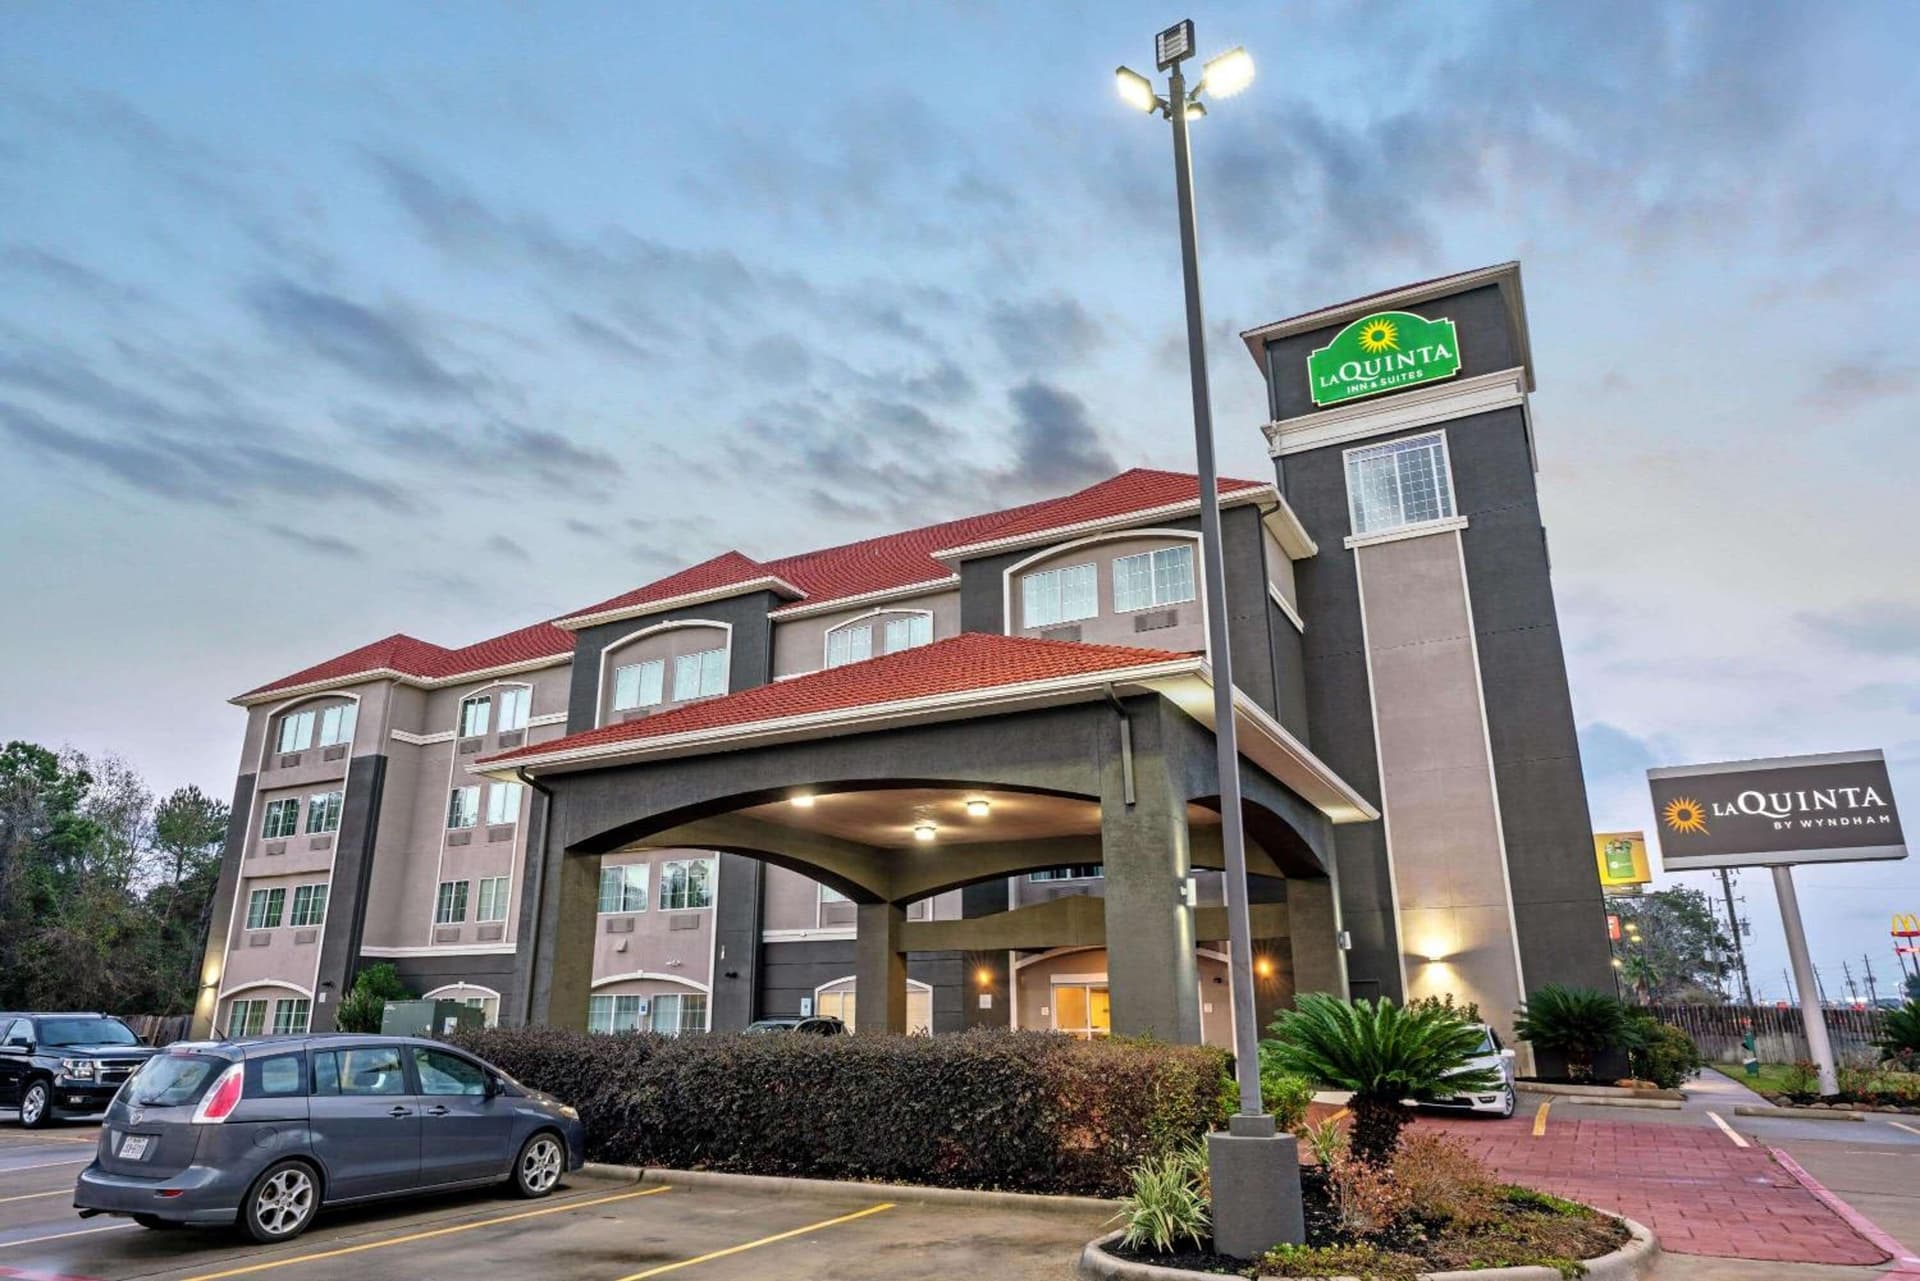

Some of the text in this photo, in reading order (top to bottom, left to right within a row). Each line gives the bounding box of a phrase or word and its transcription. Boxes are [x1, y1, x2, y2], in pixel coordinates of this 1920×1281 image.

[1320, 343, 1453, 388] LA QUINTA
[1347, 382, 1368, 394] INN
[1380, 369, 1424, 386] SUITES
[1712, 786, 1888, 818] LA QUINTA
[1774, 815, 1891, 831] BY WYNDHAM
